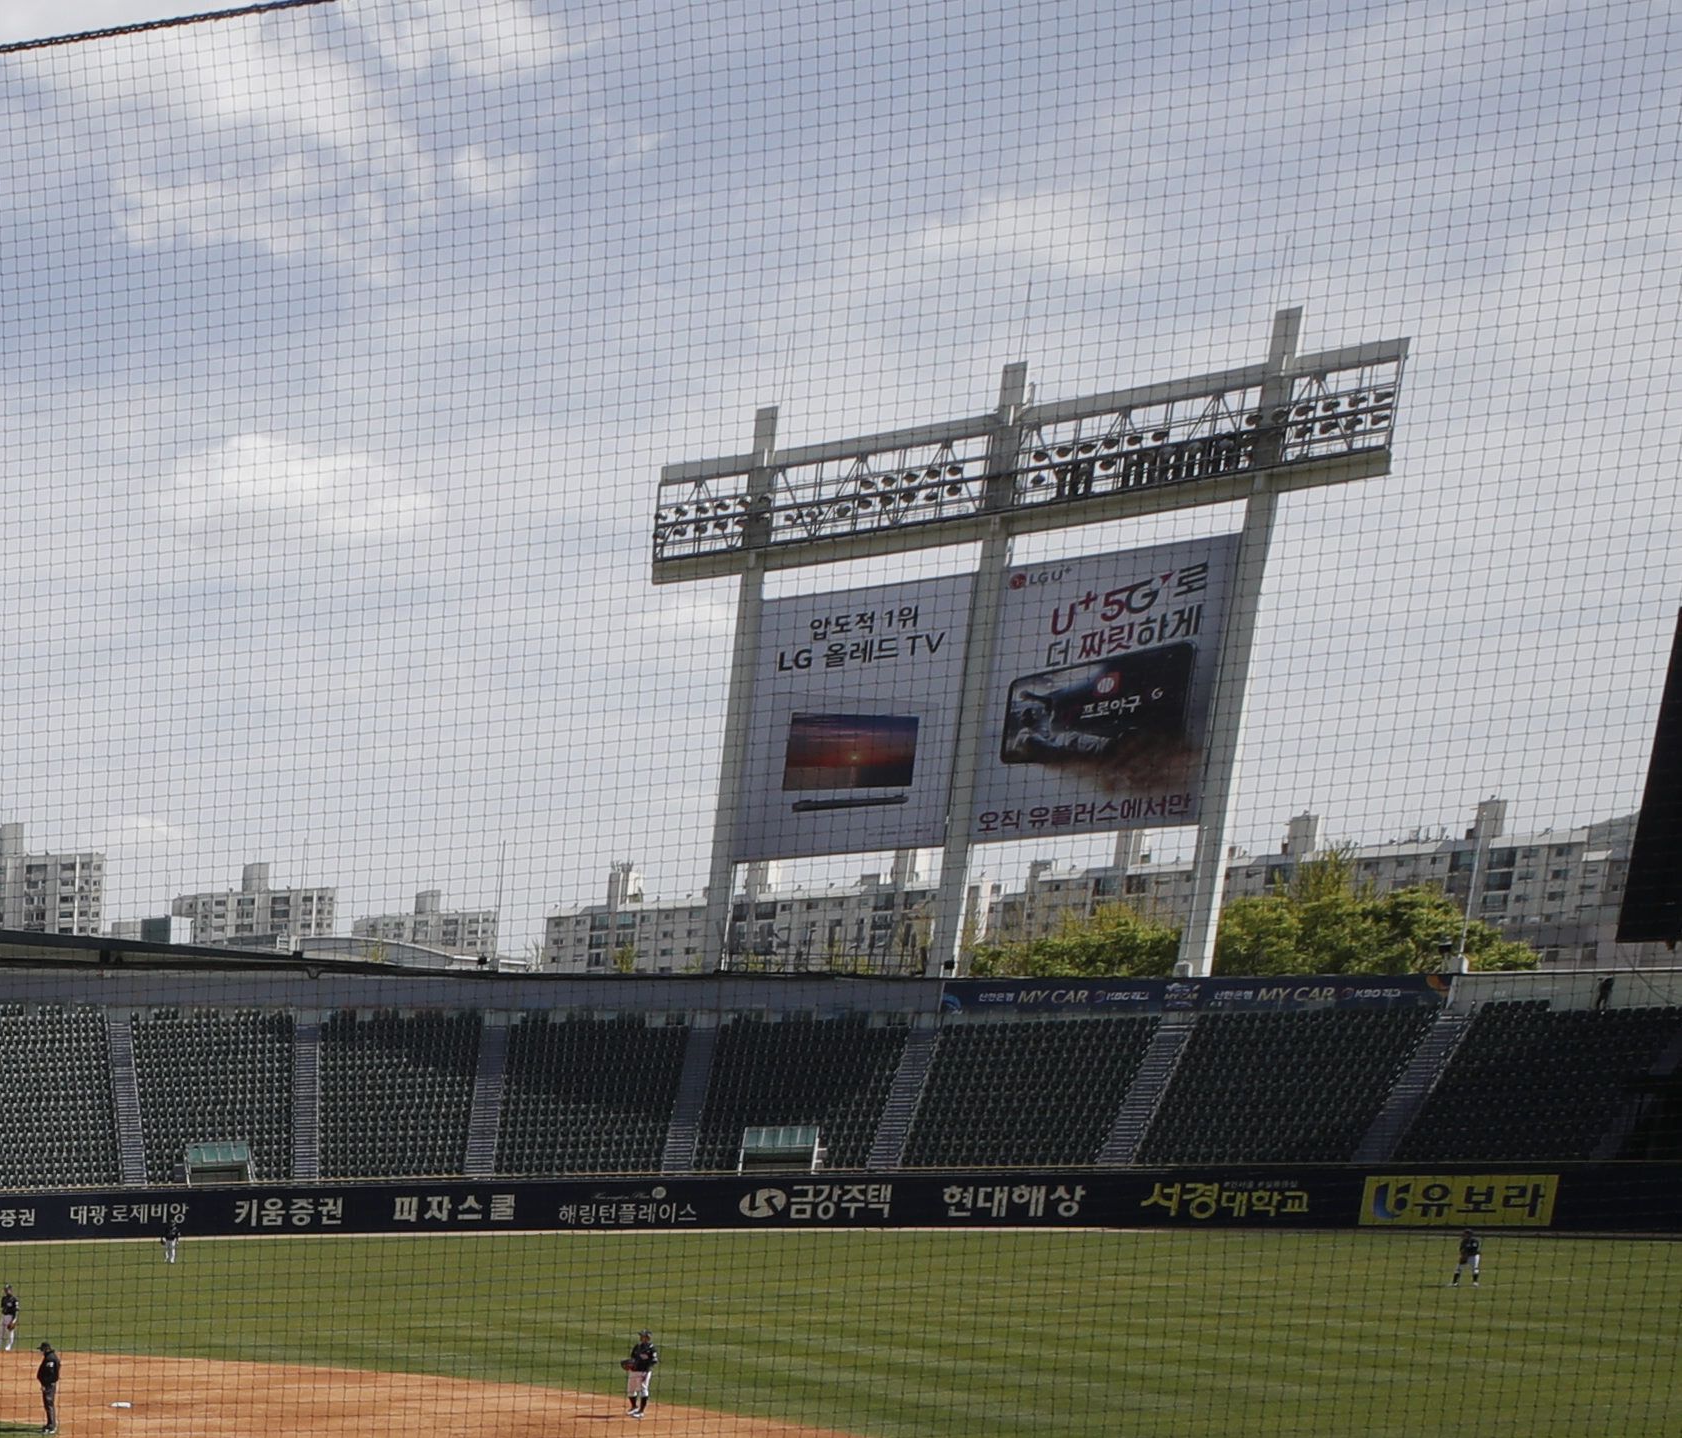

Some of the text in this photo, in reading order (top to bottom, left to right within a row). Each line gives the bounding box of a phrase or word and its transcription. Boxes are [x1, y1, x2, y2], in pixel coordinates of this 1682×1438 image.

[810, 605, 920, 641] 압도적 1위
[1046, 604, 1202, 667] 더 짜릿하게
[778, 632, 945, 672] LG 올레드 TV
[1080, 695, 1141, 719] 프로야구
[977, 793, 1192, 833] 오직 유플러스에서만
[1017, 990, 1051, 1004] MY
[1051, 989, 1089, 1004] CAR
[1256, 987, 1291, 1002] MY
[1293, 987, 1335, 1002] CAR
[234, 1197, 344, 1227] 키움증권
[394, 1193, 517, 1222] 피자스쿨
[558, 1201, 698, 1225] 해링턴플레이스
[789, 1183, 893, 1219] 금강주택
[943, 1183, 1087, 1218] 현대해상
[1140, 1181, 1309, 1219] 서경대학교
[1413, 1182, 1545, 1219] 유보라
